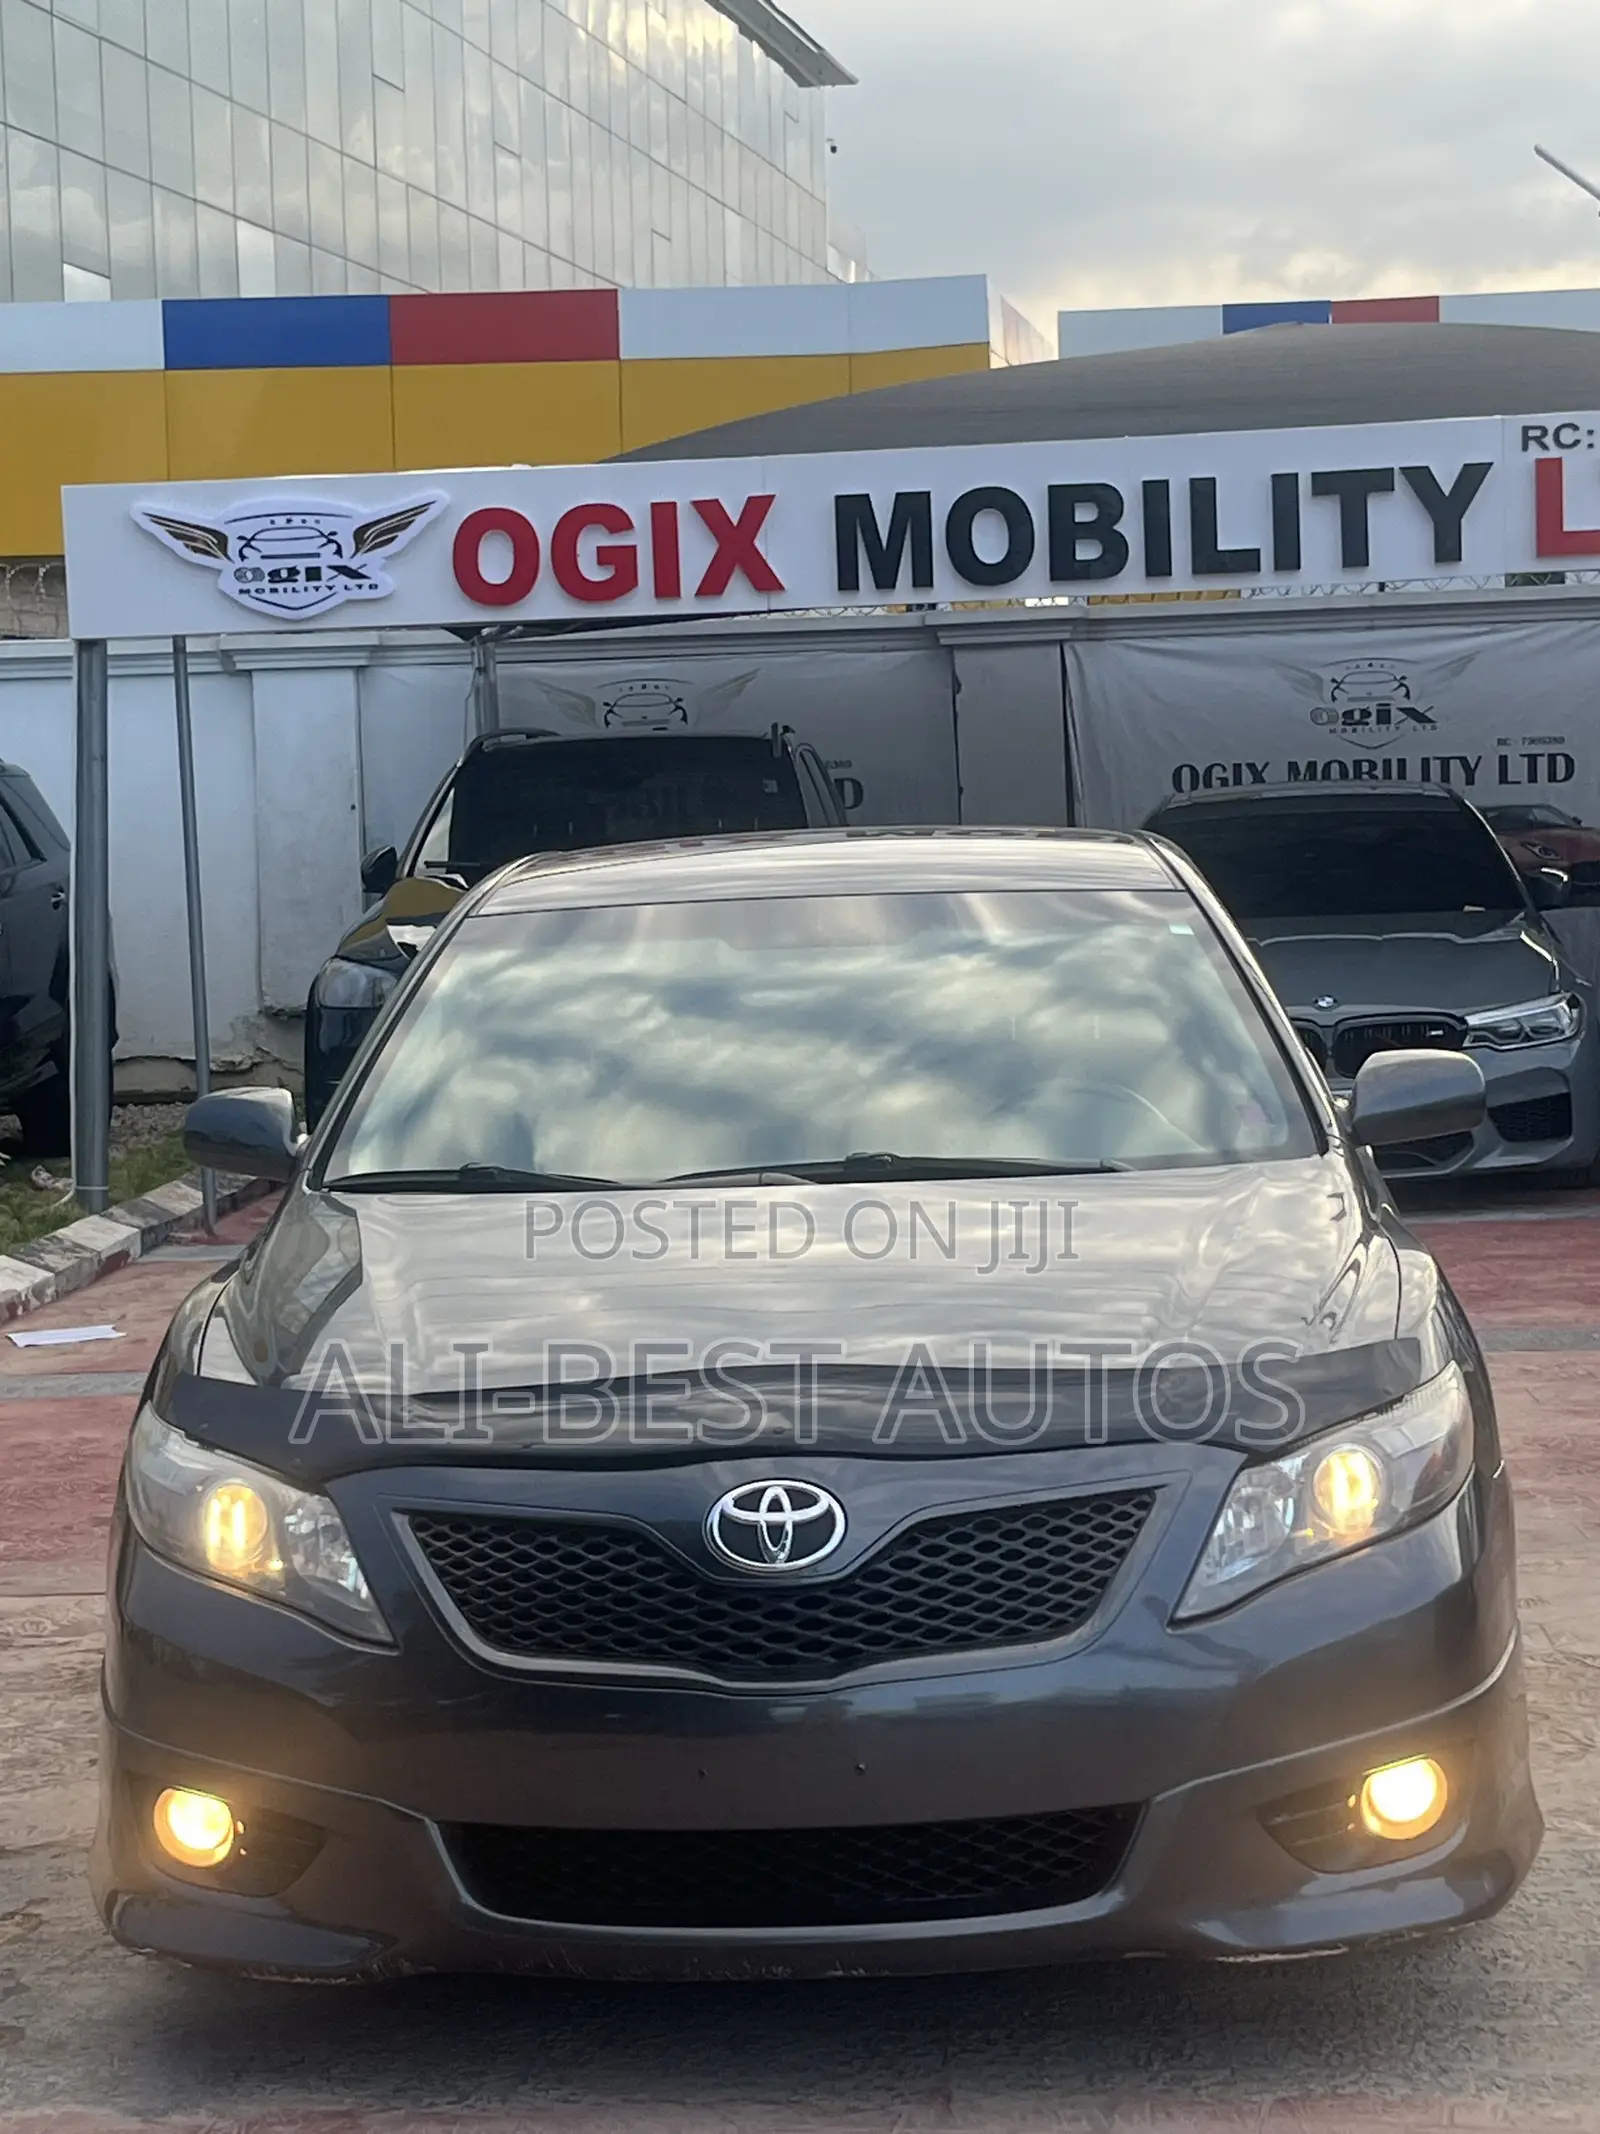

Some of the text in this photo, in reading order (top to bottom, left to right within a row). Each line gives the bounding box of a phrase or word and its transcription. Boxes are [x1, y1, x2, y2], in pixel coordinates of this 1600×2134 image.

[1520, 422, 1595, 453] RC:
[452, 493, 786, 607] OGIX
[834, 461, 1494, 592] MOBILITY
[238, 583, 379, 595] MOBILITY LTD
[1171, 752, 1575, 794] OGIX MOBILITY LTD
